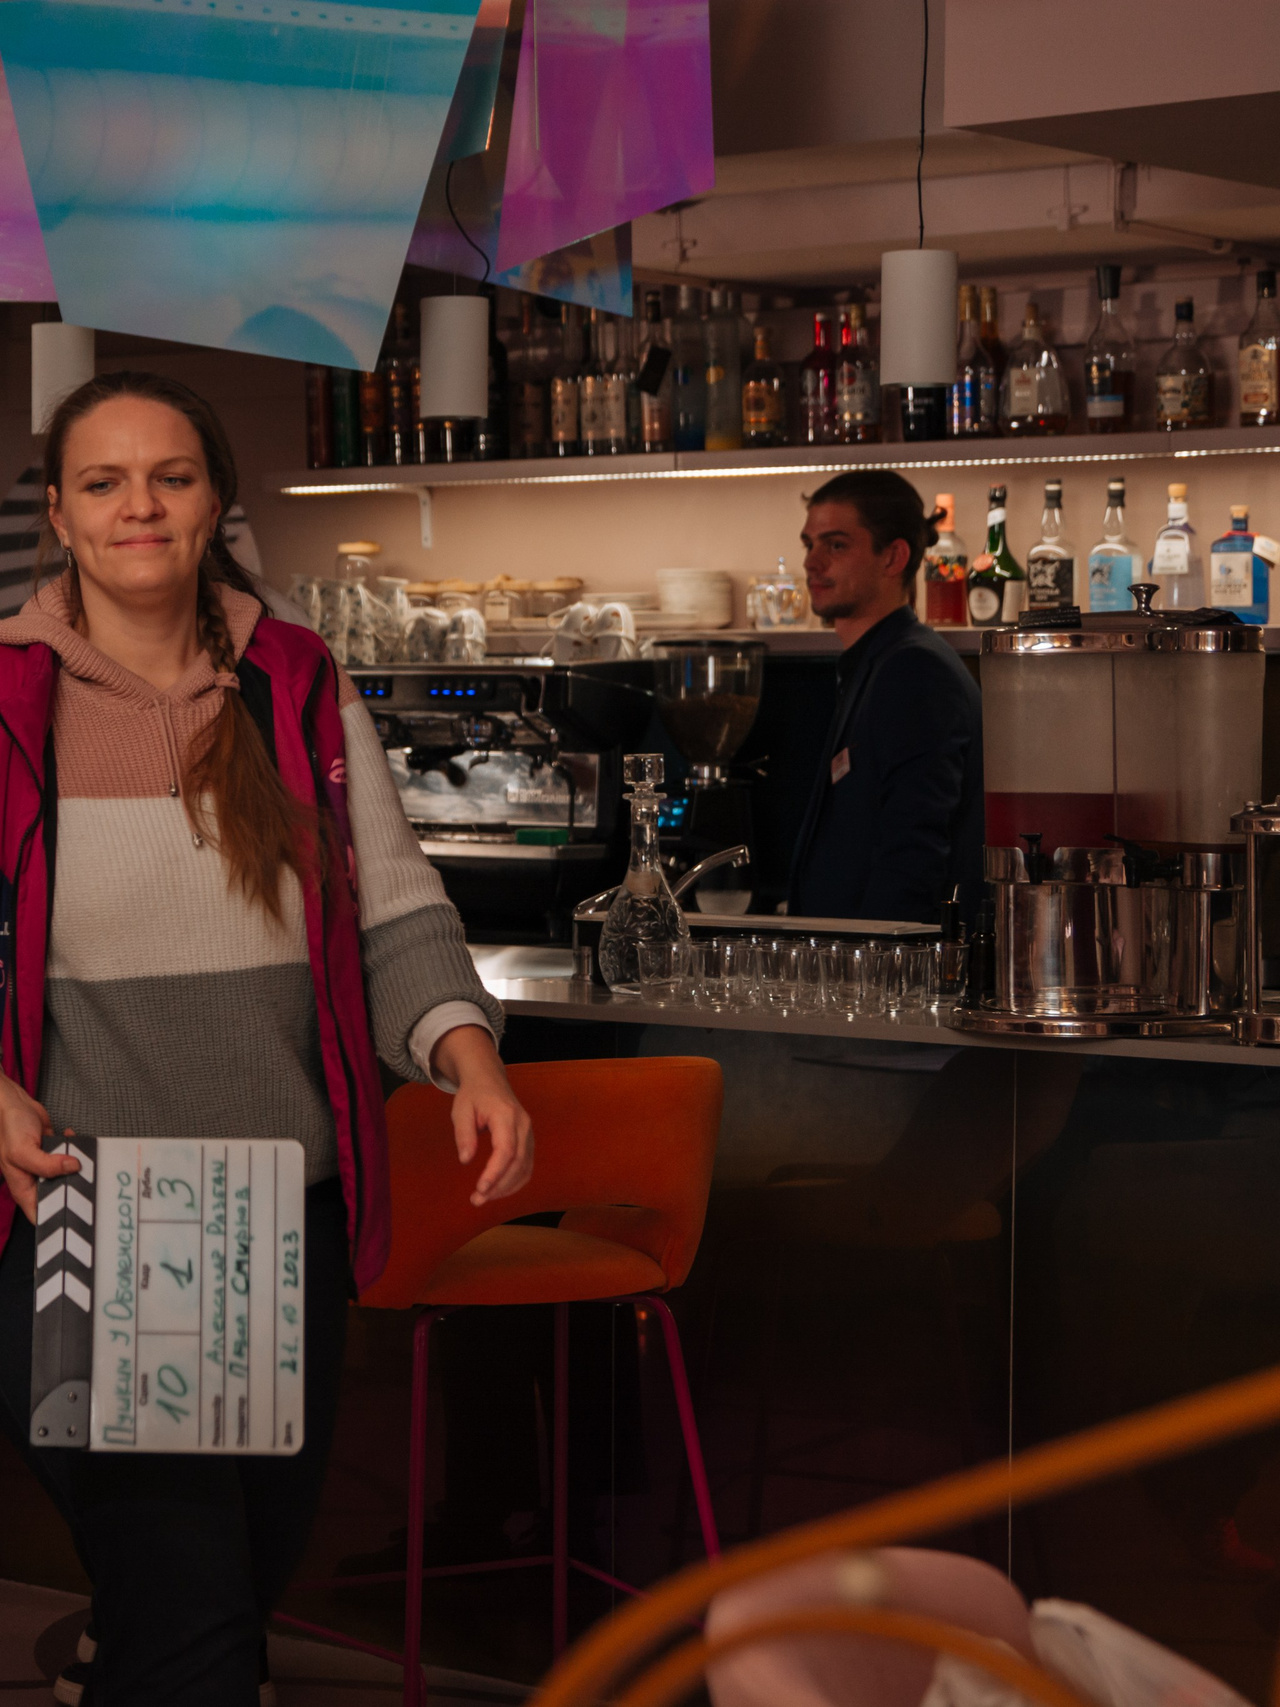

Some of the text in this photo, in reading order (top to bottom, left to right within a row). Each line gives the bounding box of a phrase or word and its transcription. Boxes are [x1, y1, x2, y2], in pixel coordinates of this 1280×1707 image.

[157, 1177, 197, 1210] 3
[160, 1258, 194, 1289] 1
[156, 1364, 190, 1423] 10
